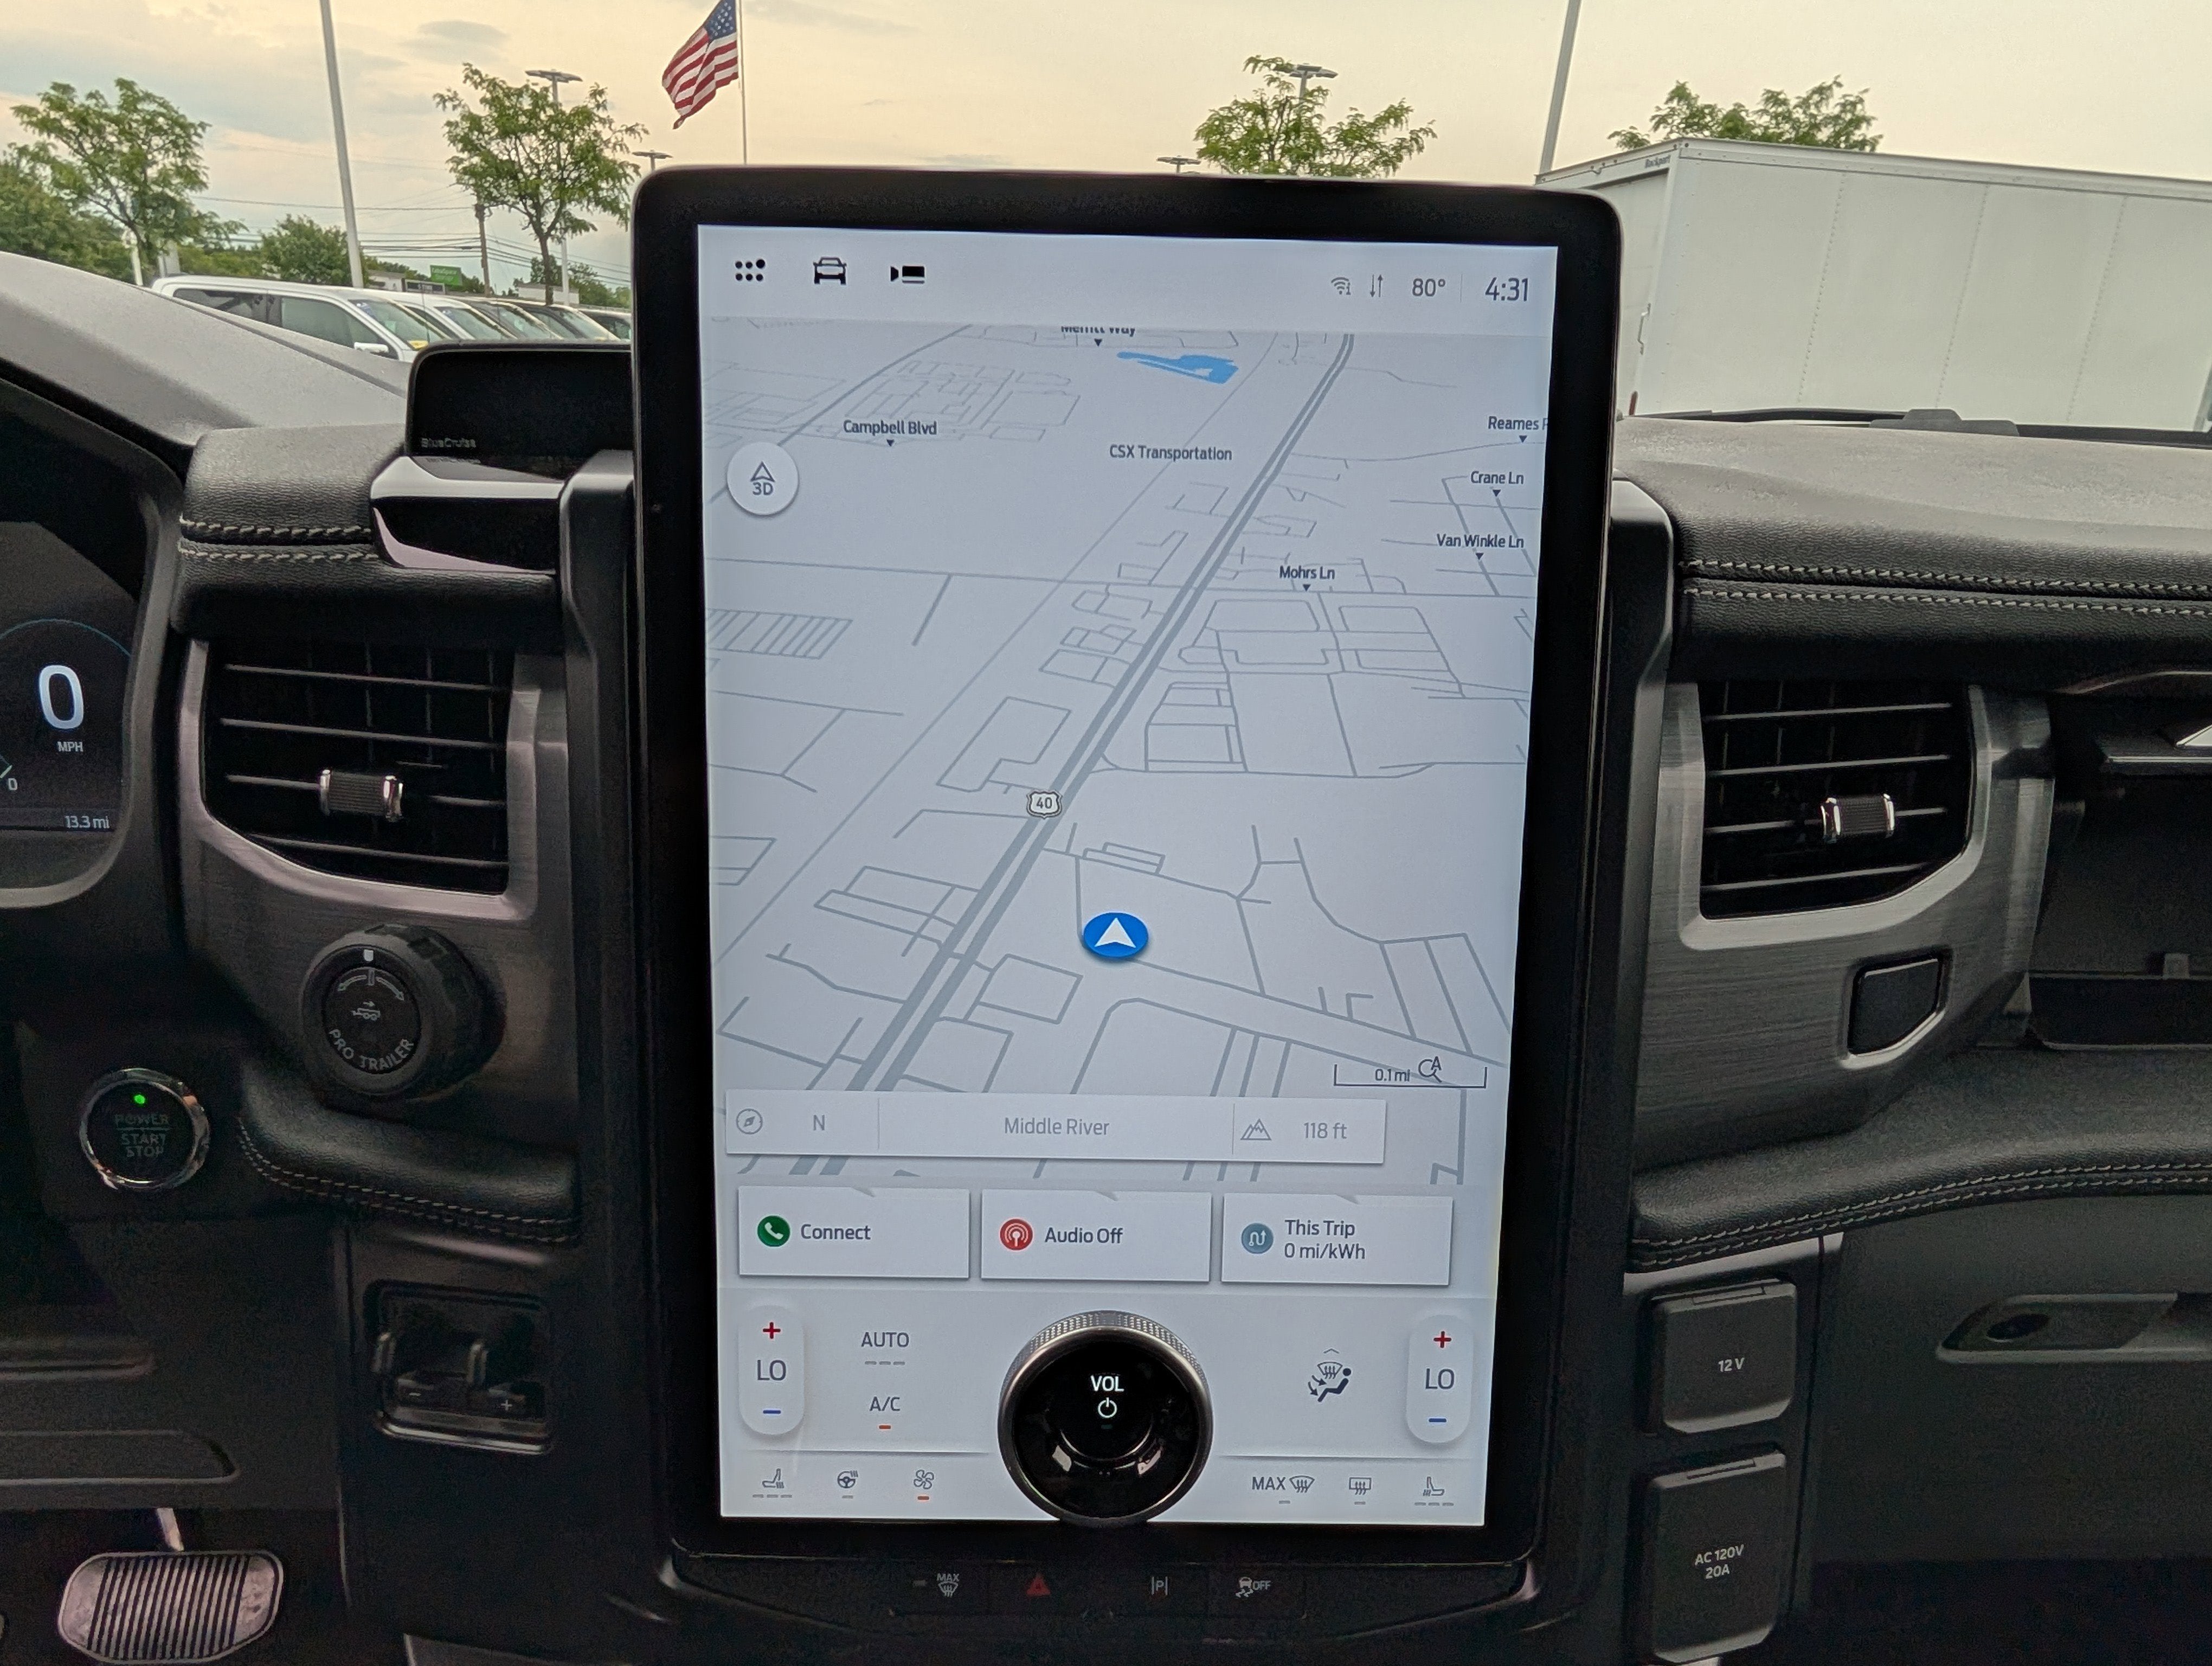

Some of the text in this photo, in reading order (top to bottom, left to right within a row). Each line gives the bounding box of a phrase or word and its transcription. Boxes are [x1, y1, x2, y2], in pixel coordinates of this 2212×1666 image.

[1412, 278, 1446, 297] 80°
[1485, 277, 1528, 302] 4:31
[843, 420, 937, 435] Campbell Blvd
[1488, 415, 1539, 430] Reames
[1109, 444, 1232, 462] CSX Transportation
[1471, 470, 1524, 485] Crane Ln
[751, 482, 774, 496] 3D
[1437, 533, 1524, 548] Van Winkle Ln
[1279, 565, 1335, 580] Mohrs Ln
[38, 664, 85, 729] 0
[57, 741, 83, 752] MPH
[1036, 797, 1052, 809] 40
[65, 815, 110, 829] 13.3 mi
[329, 1029, 414, 1071] PRO TRAILER
[114, 1114, 169, 1126] POWER
[813, 1114, 826, 1131] N
[1005, 1117, 1110, 1135] Middle River
[1303, 1122, 1347, 1139] 118 ft
[121, 1133, 166, 1145] START
[125, 1145, 164, 1157] STOP
[801, 1223, 871, 1240] Connect
[1045, 1227, 1124, 1244] Audio Off
[1284, 1219, 1355, 1238] This Trip
[1284, 1242, 1365, 1259] 0 mi/kWh
[861, 1331, 910, 1348] AUTO
[757, 1359, 787, 1381] LO
[1718, 1357, 1745, 1373] 12 V
[1090, 1375, 1124, 1392] VOL
[1425, 1368, 1455, 1389] LO
[869, 1396, 901, 1412] A/C
[1252, 1476, 1286, 1491] MAX
[1694, 1544, 1744, 1566] AC 120V
[936, 1573, 960, 1582] MAX
[1705, 1564, 1731, 1579] 20A
[1252, 1580, 1271, 1592] OFF
